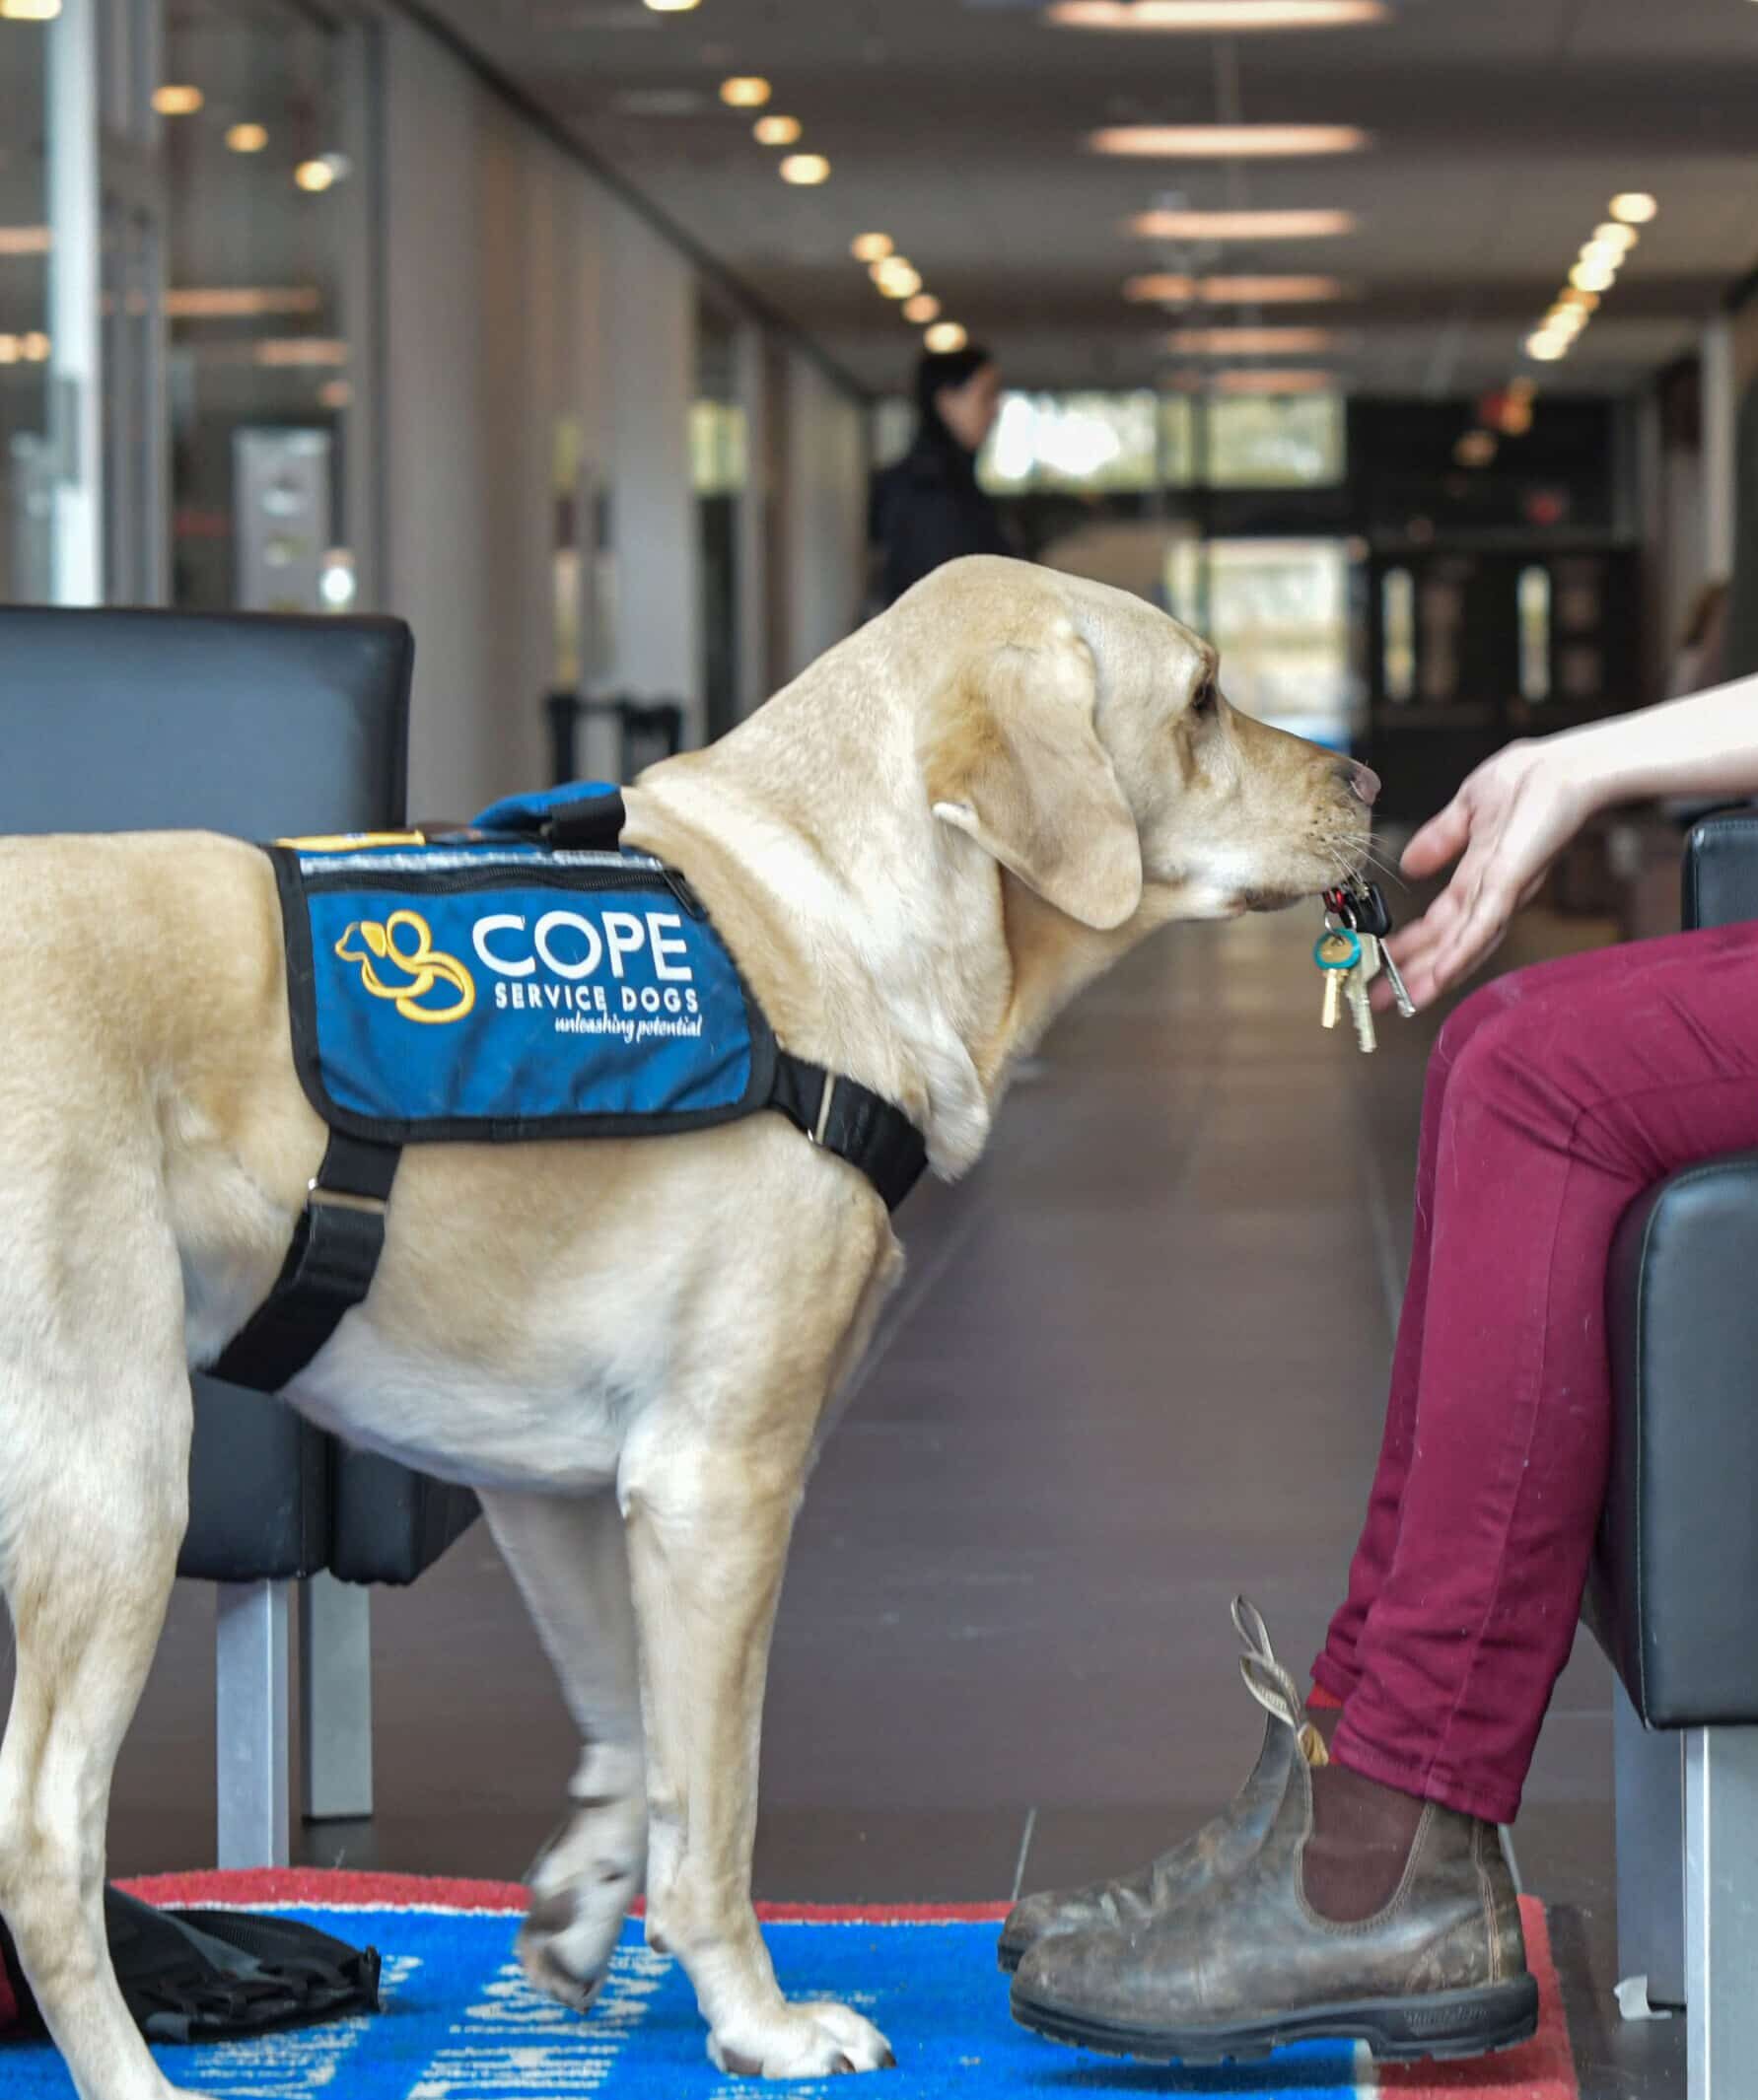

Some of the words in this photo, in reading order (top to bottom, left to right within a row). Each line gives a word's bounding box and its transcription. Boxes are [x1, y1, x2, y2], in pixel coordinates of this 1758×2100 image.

[471, 910, 693, 981] COPE
[494, 982, 607, 1011] SERVICE
[620, 985, 699, 1014] DOGS
[554, 1010, 635, 1044] unleashing
[635, 1014, 703, 1044] potential
